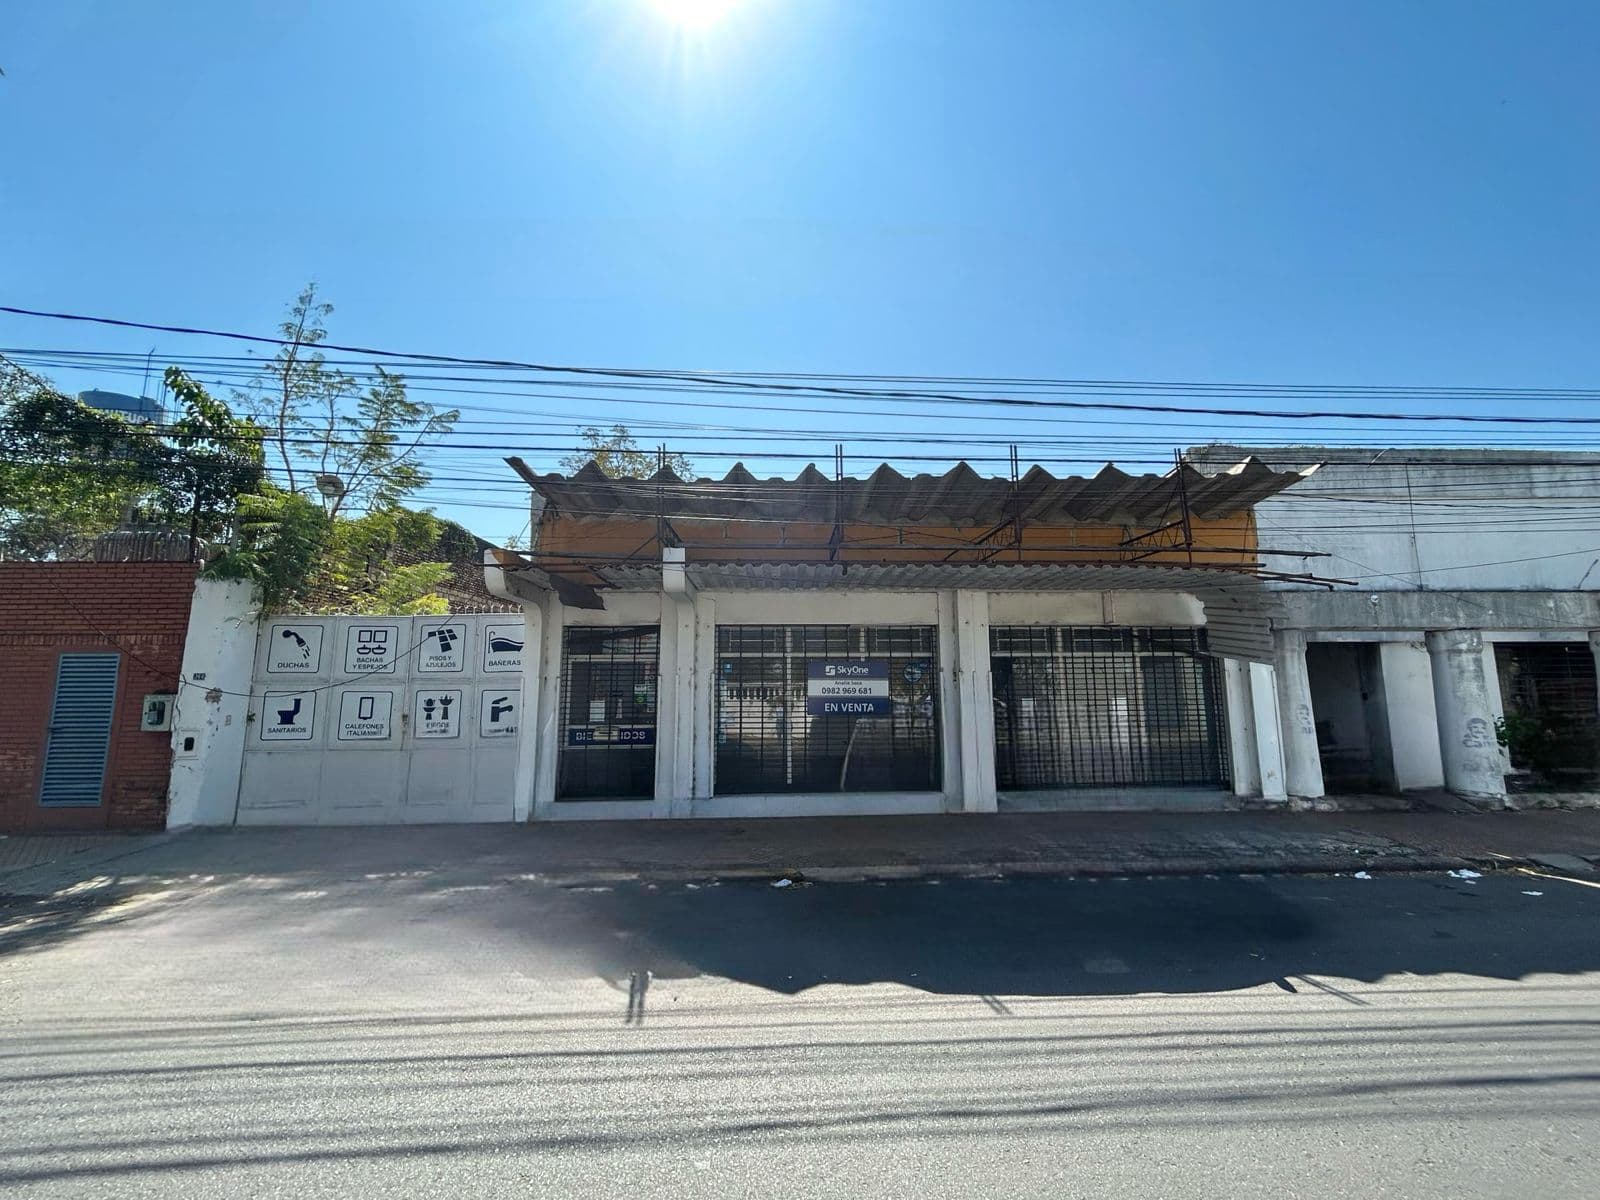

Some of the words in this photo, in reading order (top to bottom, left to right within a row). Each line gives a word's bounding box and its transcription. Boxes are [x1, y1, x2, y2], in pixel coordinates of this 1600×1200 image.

[356, 656, 384, 664] BACHAS
[488, 659, 521, 667] BAÑERAS
[277, 661, 310, 670] DUCHAS
[837, 665, 869, 676] SkyOne
[821, 687, 841, 695] 0982
[842, 687, 857, 695] 969
[858, 687, 873, 695] 681
[824, 702, 839, 713] EN
[841, 702, 875, 713] VENTA
